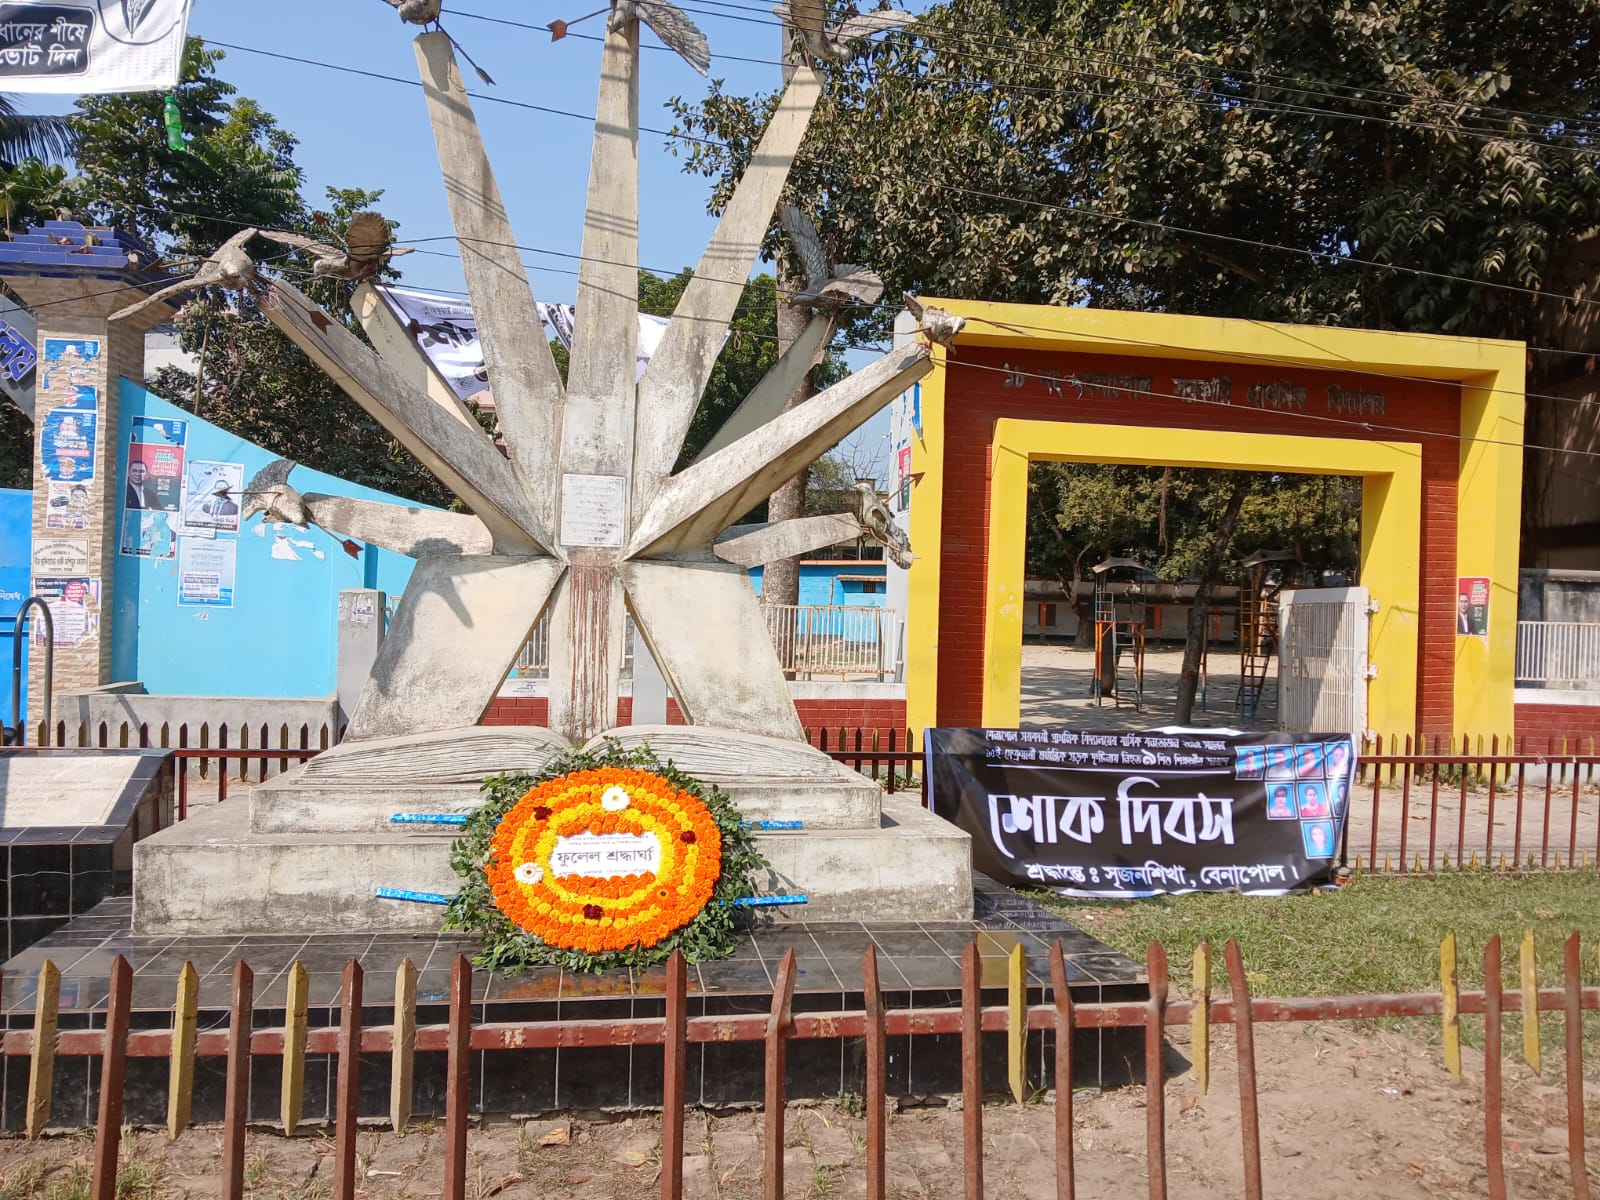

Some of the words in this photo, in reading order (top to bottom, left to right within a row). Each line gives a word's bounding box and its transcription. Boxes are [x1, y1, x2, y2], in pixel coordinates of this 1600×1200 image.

[50, 17, 88, 42] শীষে
[47, 44, 81, 66] দিন
[1142, 749, 1156, 766] ৯
[988, 793, 1106, 859] শোক
[1116, 776, 1235, 845] দিবস
[556, 851, 602, 868] ফুলেল
